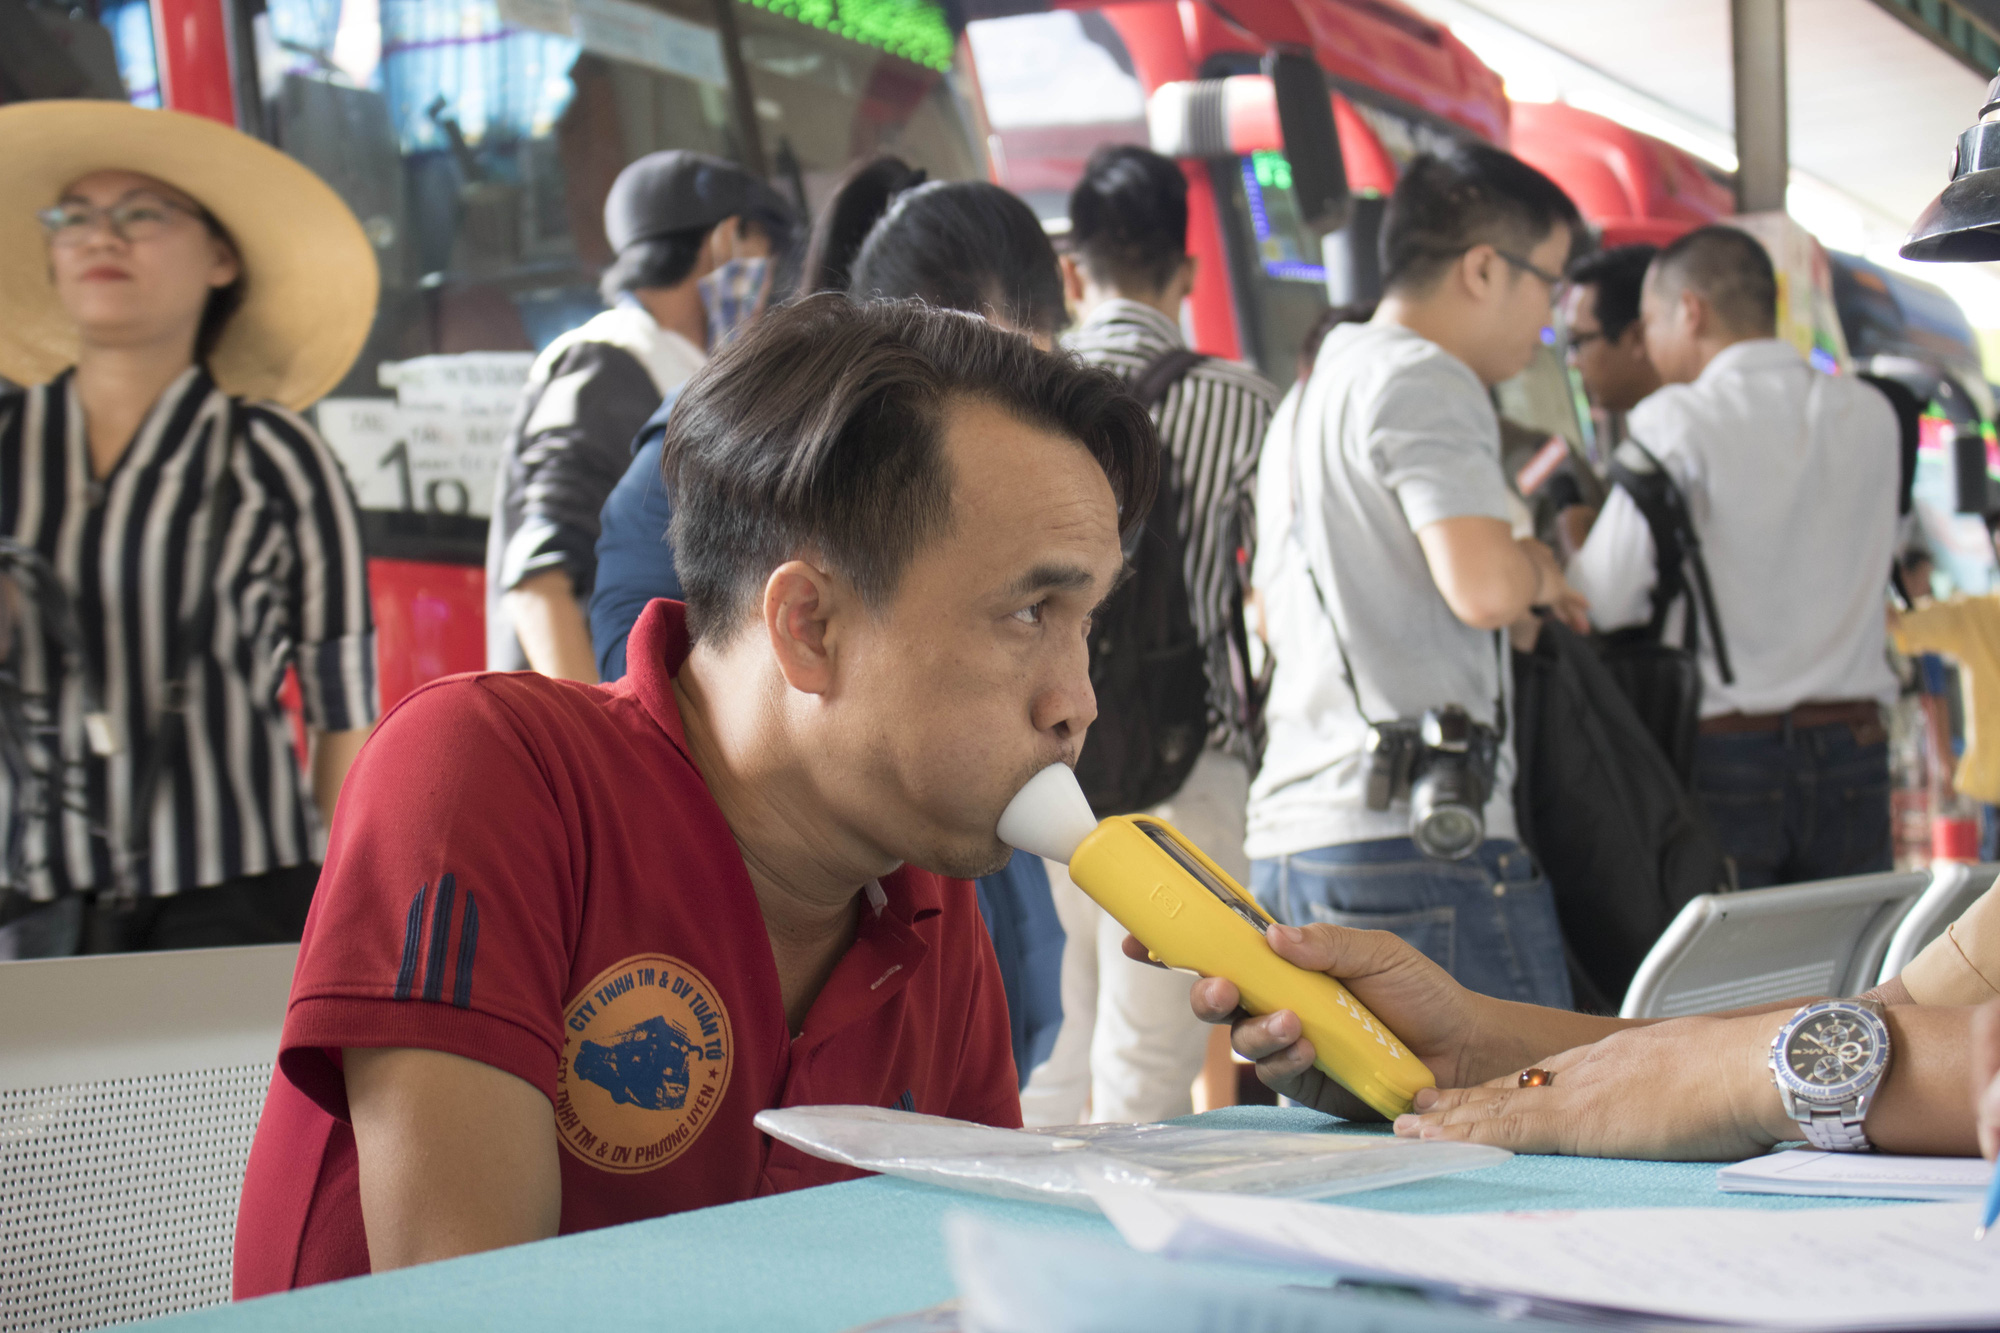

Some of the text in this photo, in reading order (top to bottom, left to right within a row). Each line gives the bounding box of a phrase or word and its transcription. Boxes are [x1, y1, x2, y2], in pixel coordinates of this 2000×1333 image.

[568, 1000, 598, 1032] CTY
[594, 971, 635, 1006] TNHH
[637, 968, 655, 987] TM
[659, 971, 669, 988] &
[671, 976, 694, 999] DV
[557, 1089, 580, 1131] TNHH
[573, 1125, 598, 1151] TM
[595, 1141, 609, 1158] &
[611, 1145, 632, 1163] DV
